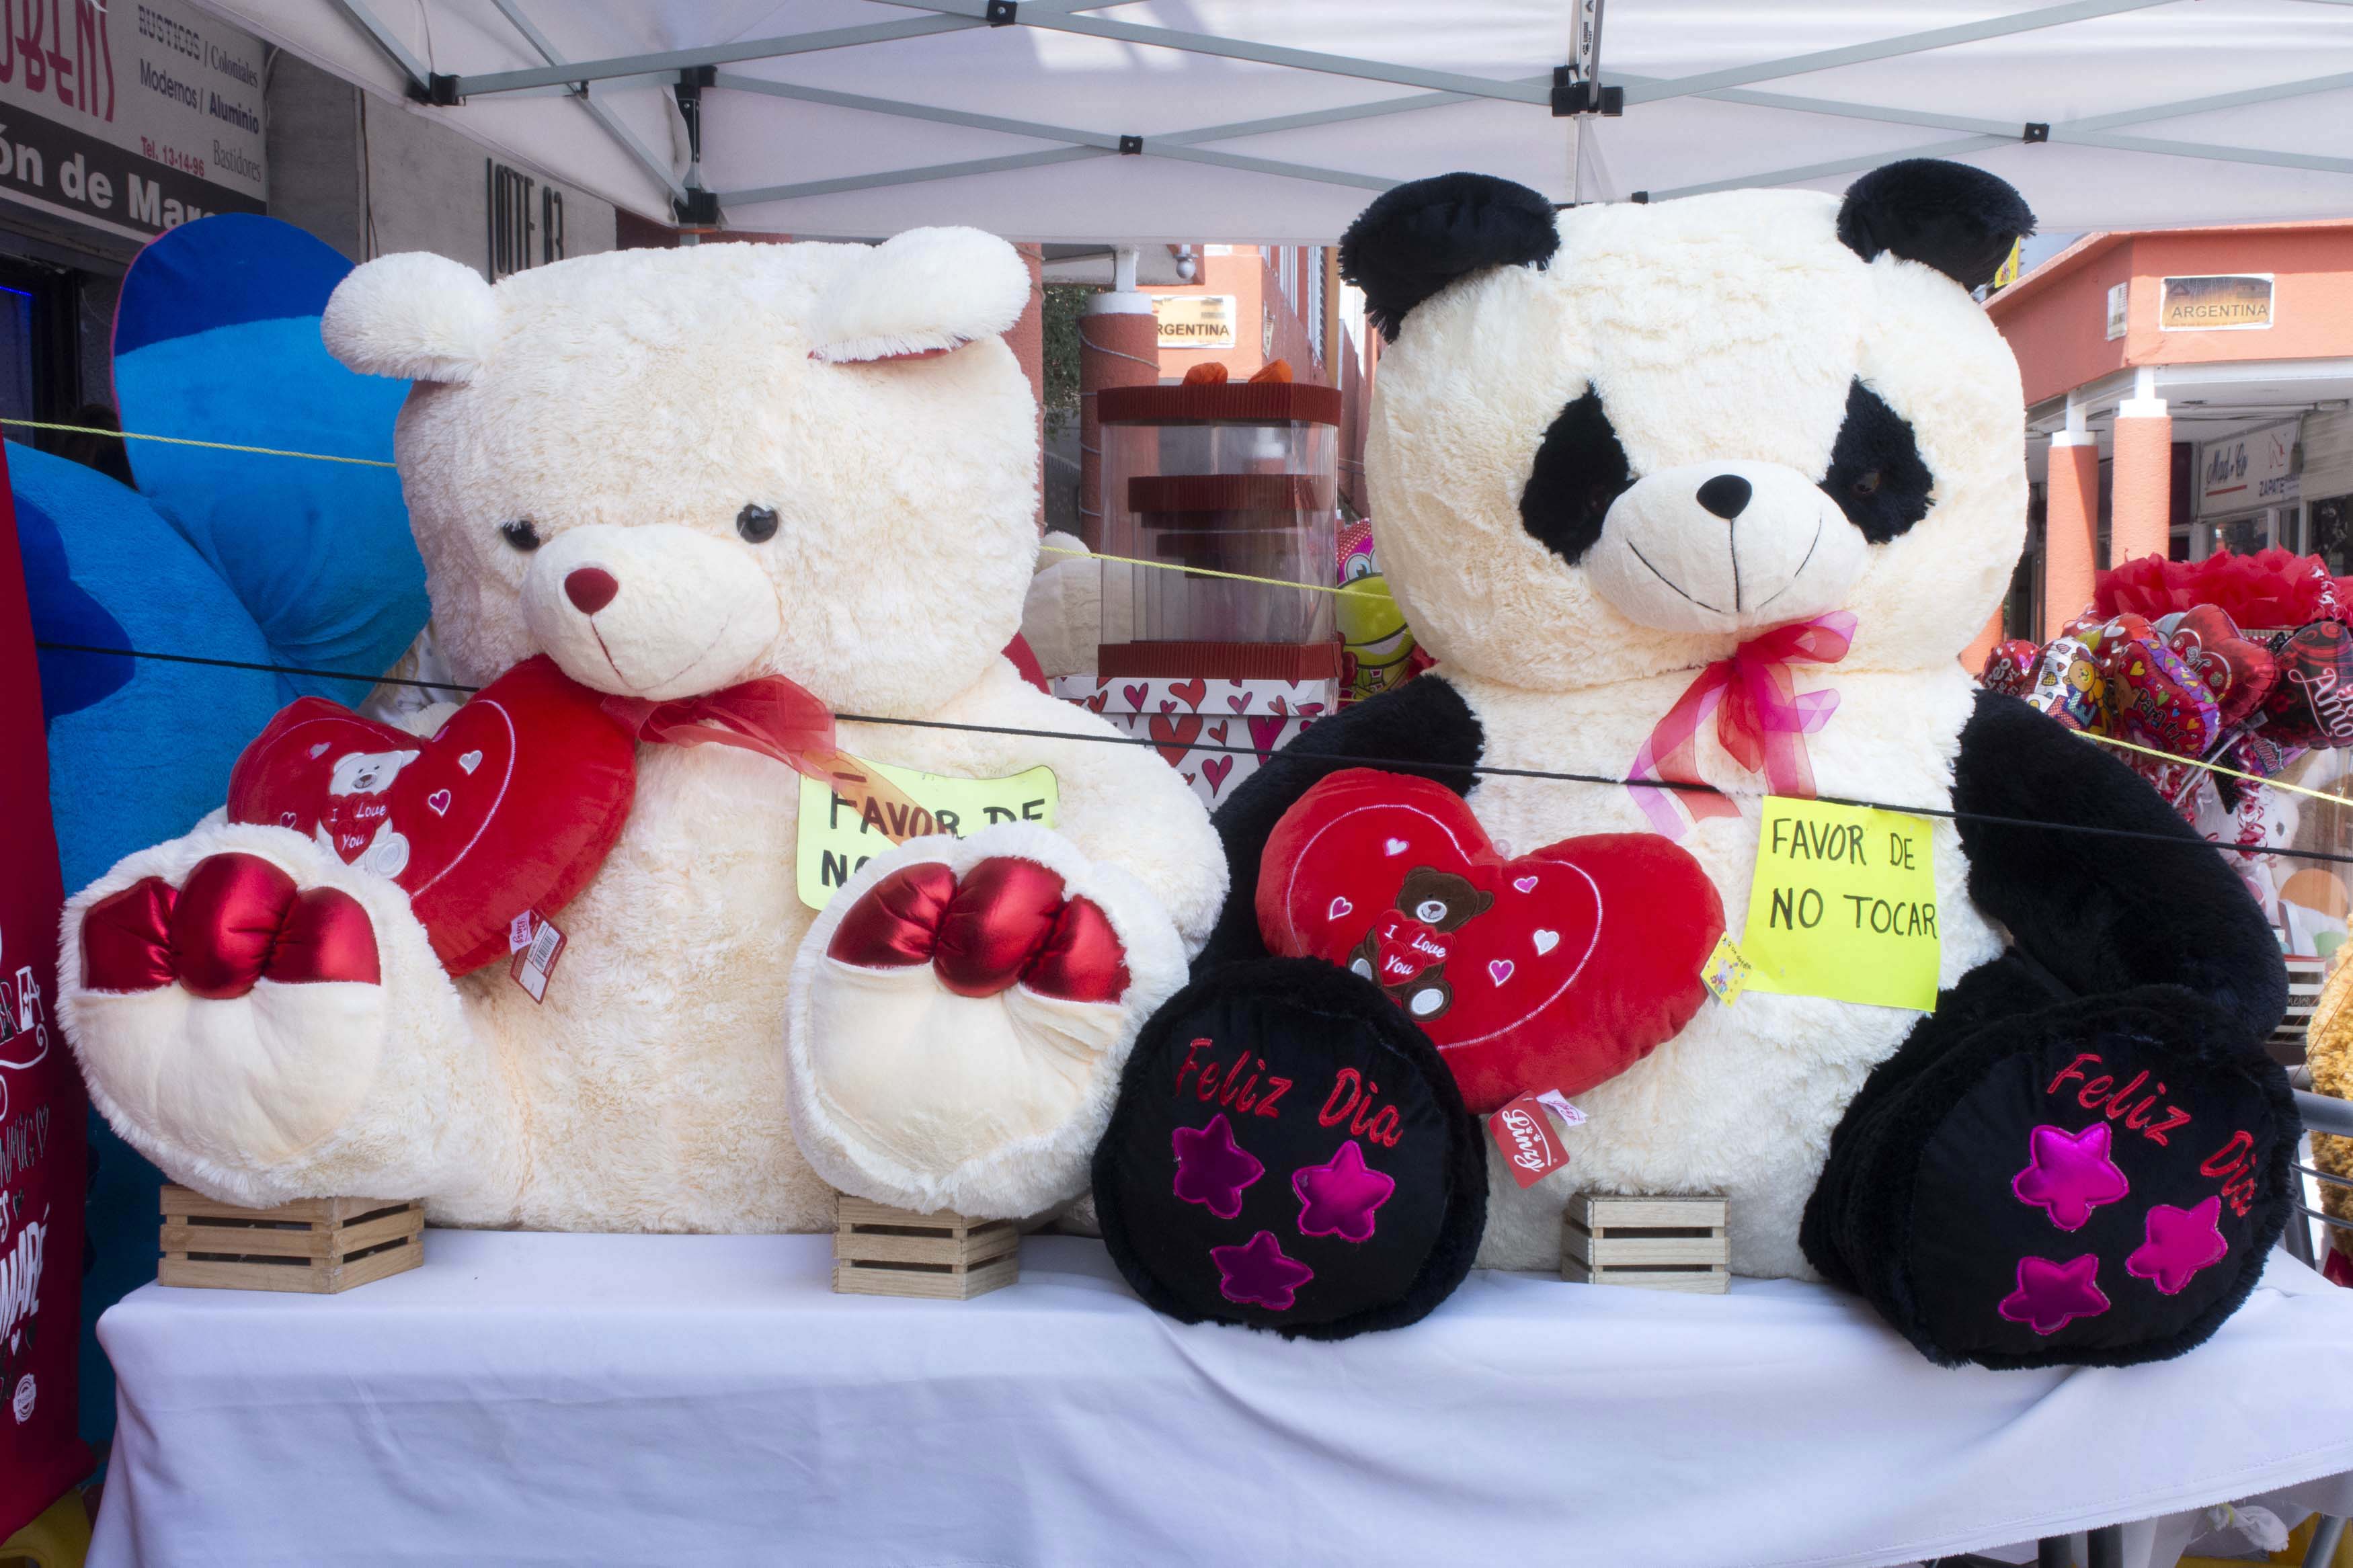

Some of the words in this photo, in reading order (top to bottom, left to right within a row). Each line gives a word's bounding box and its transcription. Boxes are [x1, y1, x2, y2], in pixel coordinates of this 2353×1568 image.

[210, 44, 258, 89] Coloniales
[140, 58, 197, 110] Modernos
[210, 91, 260, 134] Aluminio
[59, 152, 114, 210] de
[162, 145, 204, 177] 13-14-96
[213, 139, 262, 182] Bastidores
[1158, 323, 1230, 336] RGENTINA
[2171, 304, 2268, 319] ARGENTINA
[330, 808, 338, 822] I
[830, 772, 967, 841] FAVOR
[341, 833, 366, 852] You
[1771, 817, 1867, 866] FAVOR
[1889, 832, 1915, 870] DE
[1384, 924, 1398, 940] I
[1769, 886, 1824, 930] NO
[1843, 894, 1938, 940] TOCAR
[1384, 954, 1414, 975] You
[1175, 1038, 1293, 1118] Feliz
[1318, 1067, 1404, 1148] Dia
[2047, 1053, 2192, 1147] Feliz
[2200, 1130, 2258, 1217] Dia
